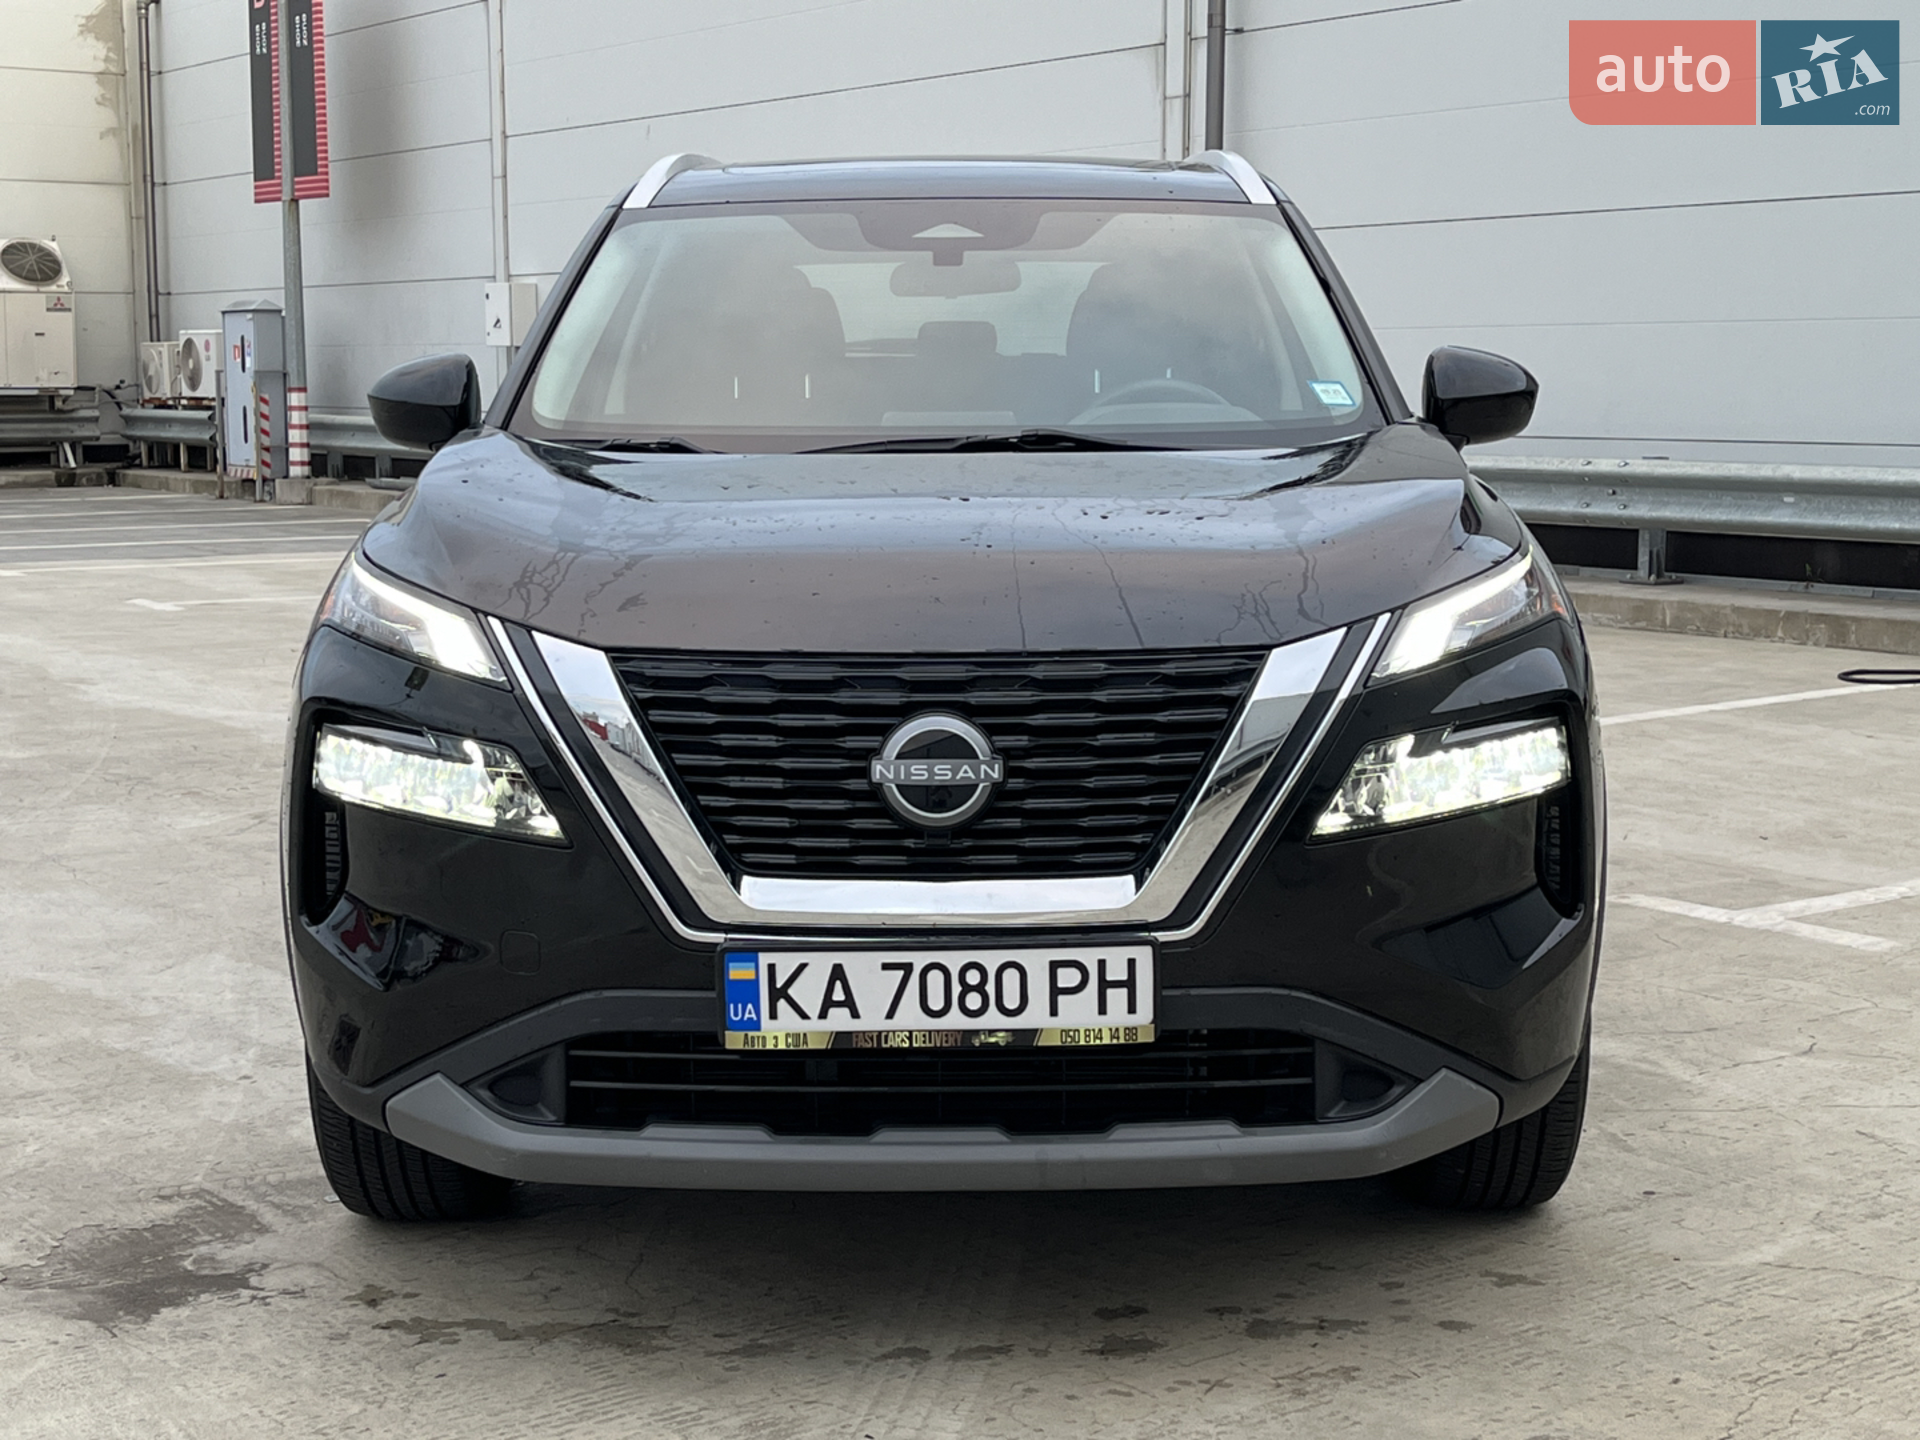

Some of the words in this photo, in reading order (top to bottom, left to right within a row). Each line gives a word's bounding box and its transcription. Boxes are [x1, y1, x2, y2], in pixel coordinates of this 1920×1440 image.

[875, 763, 999, 780] NISSAN
[766, 961, 861, 1021] KA
[880, 960, 1030, 1021] 7080
[1048, 957, 1138, 1018] PH
[729, 1003, 757, 1021] UA
[784, 1033, 809, 1048] США
[852, 1031, 879, 1048] FAST
[881, 1031, 909, 1048] CARS
[912, 1030, 963, 1047] DELIVERY
[1060, 1028, 1081, 1044] 050
[1084, 1027, 1104, 1043] 814
[1108, 1027, 1120, 1042] 14
[1123, 1026, 1139, 1042] 88
